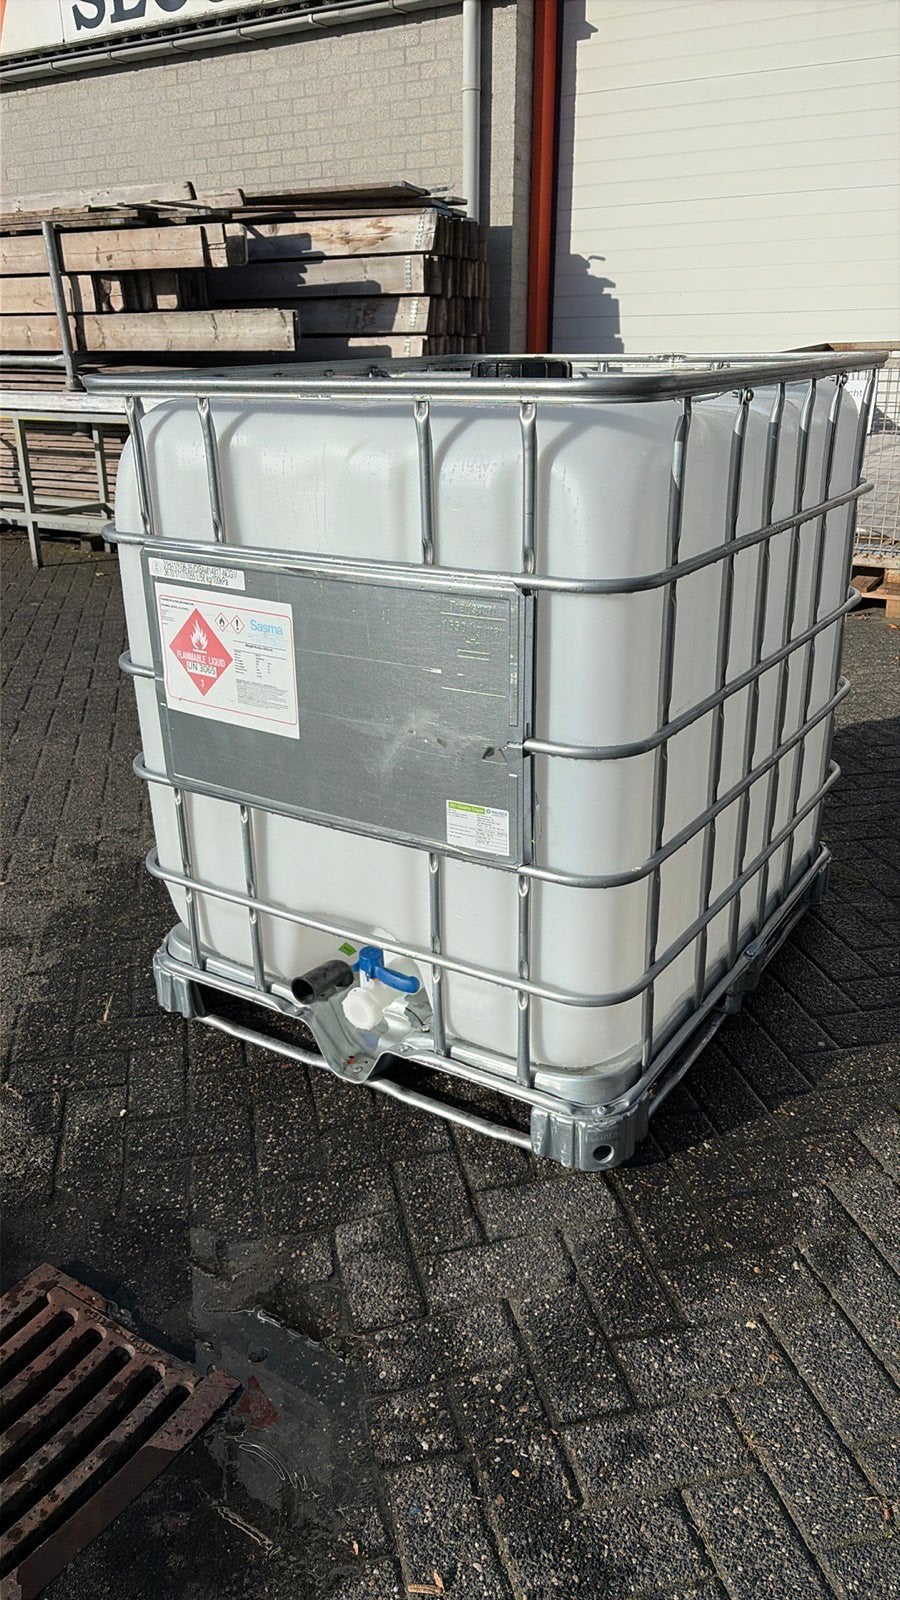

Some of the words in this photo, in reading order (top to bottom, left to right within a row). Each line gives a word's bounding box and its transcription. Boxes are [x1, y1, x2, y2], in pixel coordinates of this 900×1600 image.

[176, 649, 207, 664] FLAMMABLE
[208, 656, 226, 668] LIQUID
[187, 661, 198, 671] UN
[199, 663, 216, 675] 3065
[200, 679, 205, 688] 3
